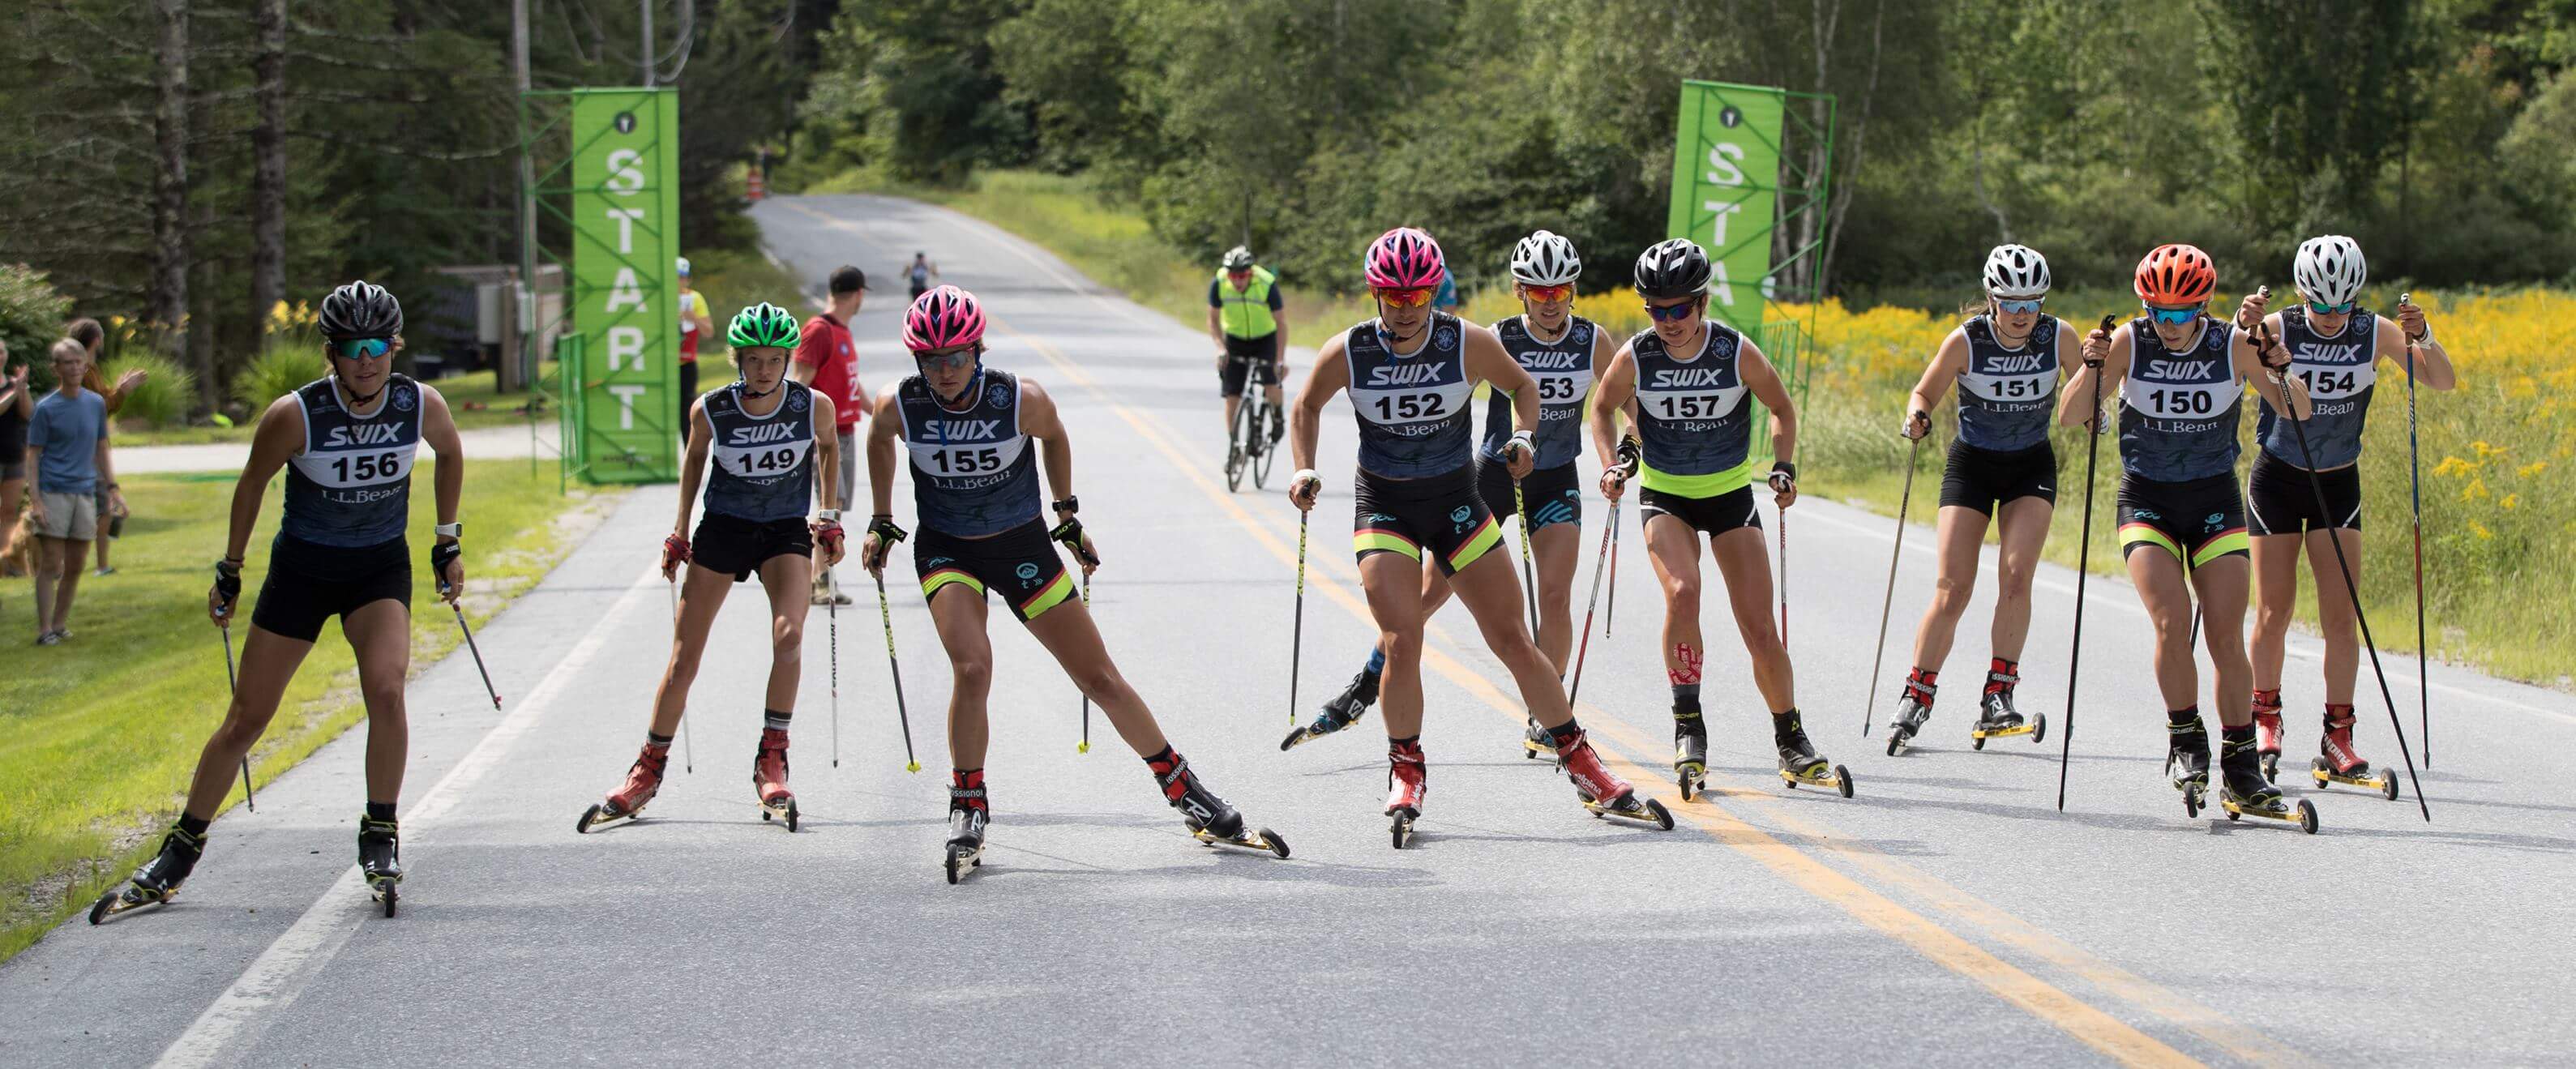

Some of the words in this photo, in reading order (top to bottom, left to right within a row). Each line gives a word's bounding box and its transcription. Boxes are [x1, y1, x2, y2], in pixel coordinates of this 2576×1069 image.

[1705, 142, 1744, 306] STA
[605, 148, 648, 430] START
[1521, 351, 1580, 369] SWIX
[1983, 353, 2044, 373] SWIX
[2299, 343, 2362, 361] SWIX
[1367, 362, 1446, 386] SWIX
[1650, 368, 1722, 387] SWIX
[2143, 359, 2216, 380] SWIX
[1539, 377, 1575, 400] 53
[1990, 378, 2040, 397] 151
[1375, 392, 1446, 420] 152
[1660, 395, 1720, 417] 157
[2150, 389, 2213, 414] 150
[2310, 400, 2355, 416] .Bean
[1539, 408, 1576, 421] Bean
[729, 421, 798, 444] SWIX
[922, 420, 1000, 441] SWIX
[332, 452, 399, 482] 156
[738, 448, 795, 473] 149
[932, 447, 1001, 473] 155
[951, 789, 983, 797] ossignol
